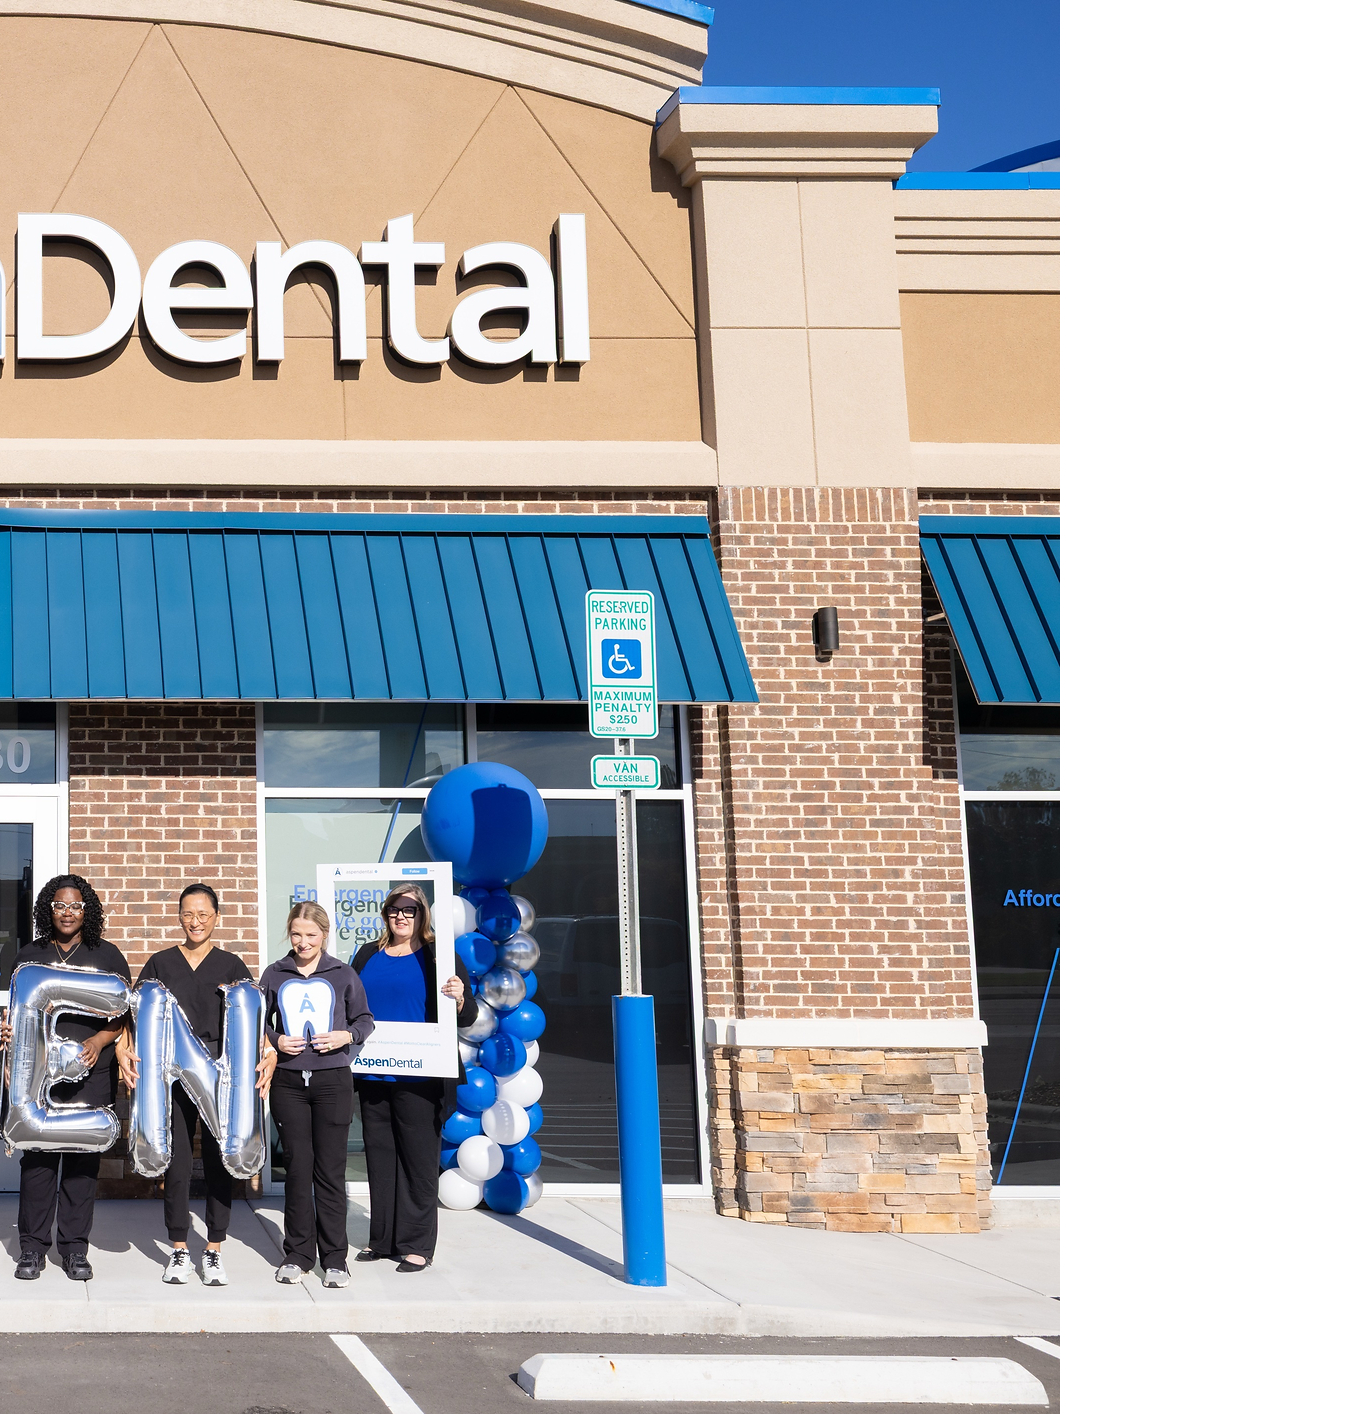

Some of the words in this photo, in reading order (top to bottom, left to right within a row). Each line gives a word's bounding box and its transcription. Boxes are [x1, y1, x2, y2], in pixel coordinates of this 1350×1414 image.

[591, 600, 649, 614] RESERVED
[595, 618, 647, 631] PARKING
[594, 691, 652, 701] MAXIMUM
[595, 703, 652, 713] PENALTY
[609, 714, 638, 725] $250
[613, 763, 638, 773] VAN
[603, 774, 650, 783] ACCESSIBLE
